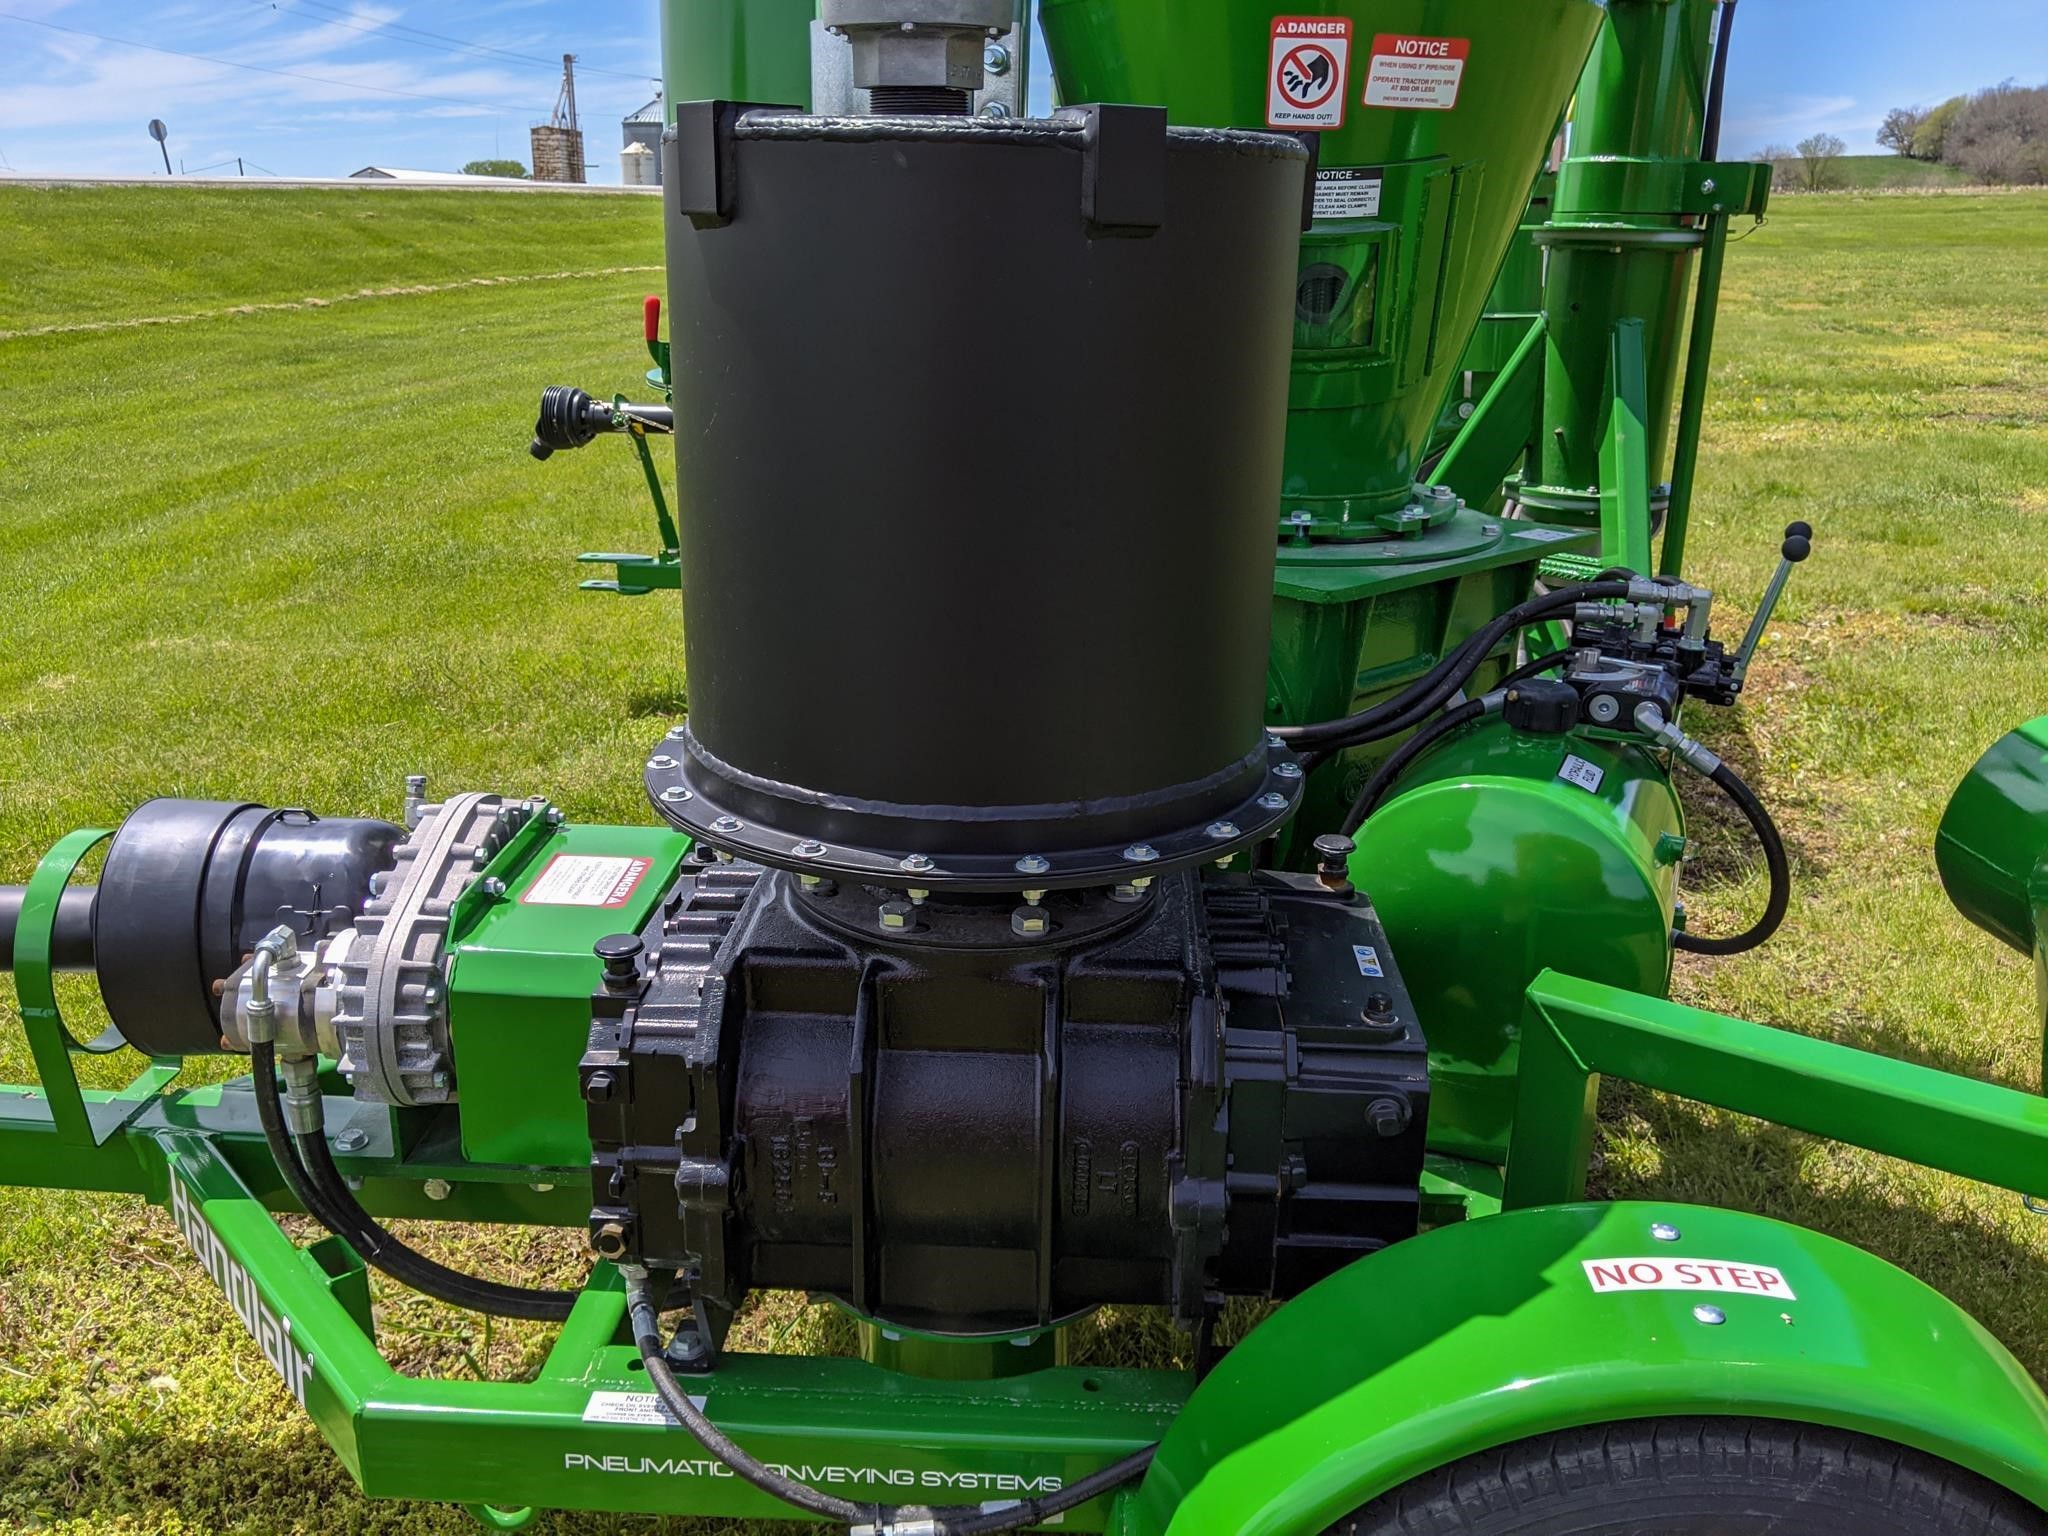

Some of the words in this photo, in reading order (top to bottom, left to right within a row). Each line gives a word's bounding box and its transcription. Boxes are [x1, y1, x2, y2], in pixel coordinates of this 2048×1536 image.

[1288, 22, 1345, 34] DANGER
[1395, 40, 1449, 56] NOTICE
[1398, 62, 1416, 70] USING
[1372, 76, 1401, 84] OPERATE
[1402, 78, 1429, 86] TRACTOR
[1316, 170, 1353, 180] NOTICE
[615, 866, 644, 898] DANGER
[1592, 1263, 1664, 1287] NO
[1674, 1264, 1779, 1292] STEP
[625, 1395, 663, 1404] NOTIC
[563, 1452, 734, 1478] PNEUMATIC
[764, 1463, 914, 1486] ONVEYING
[920, 1471, 1062, 1492] SYSTEMS
